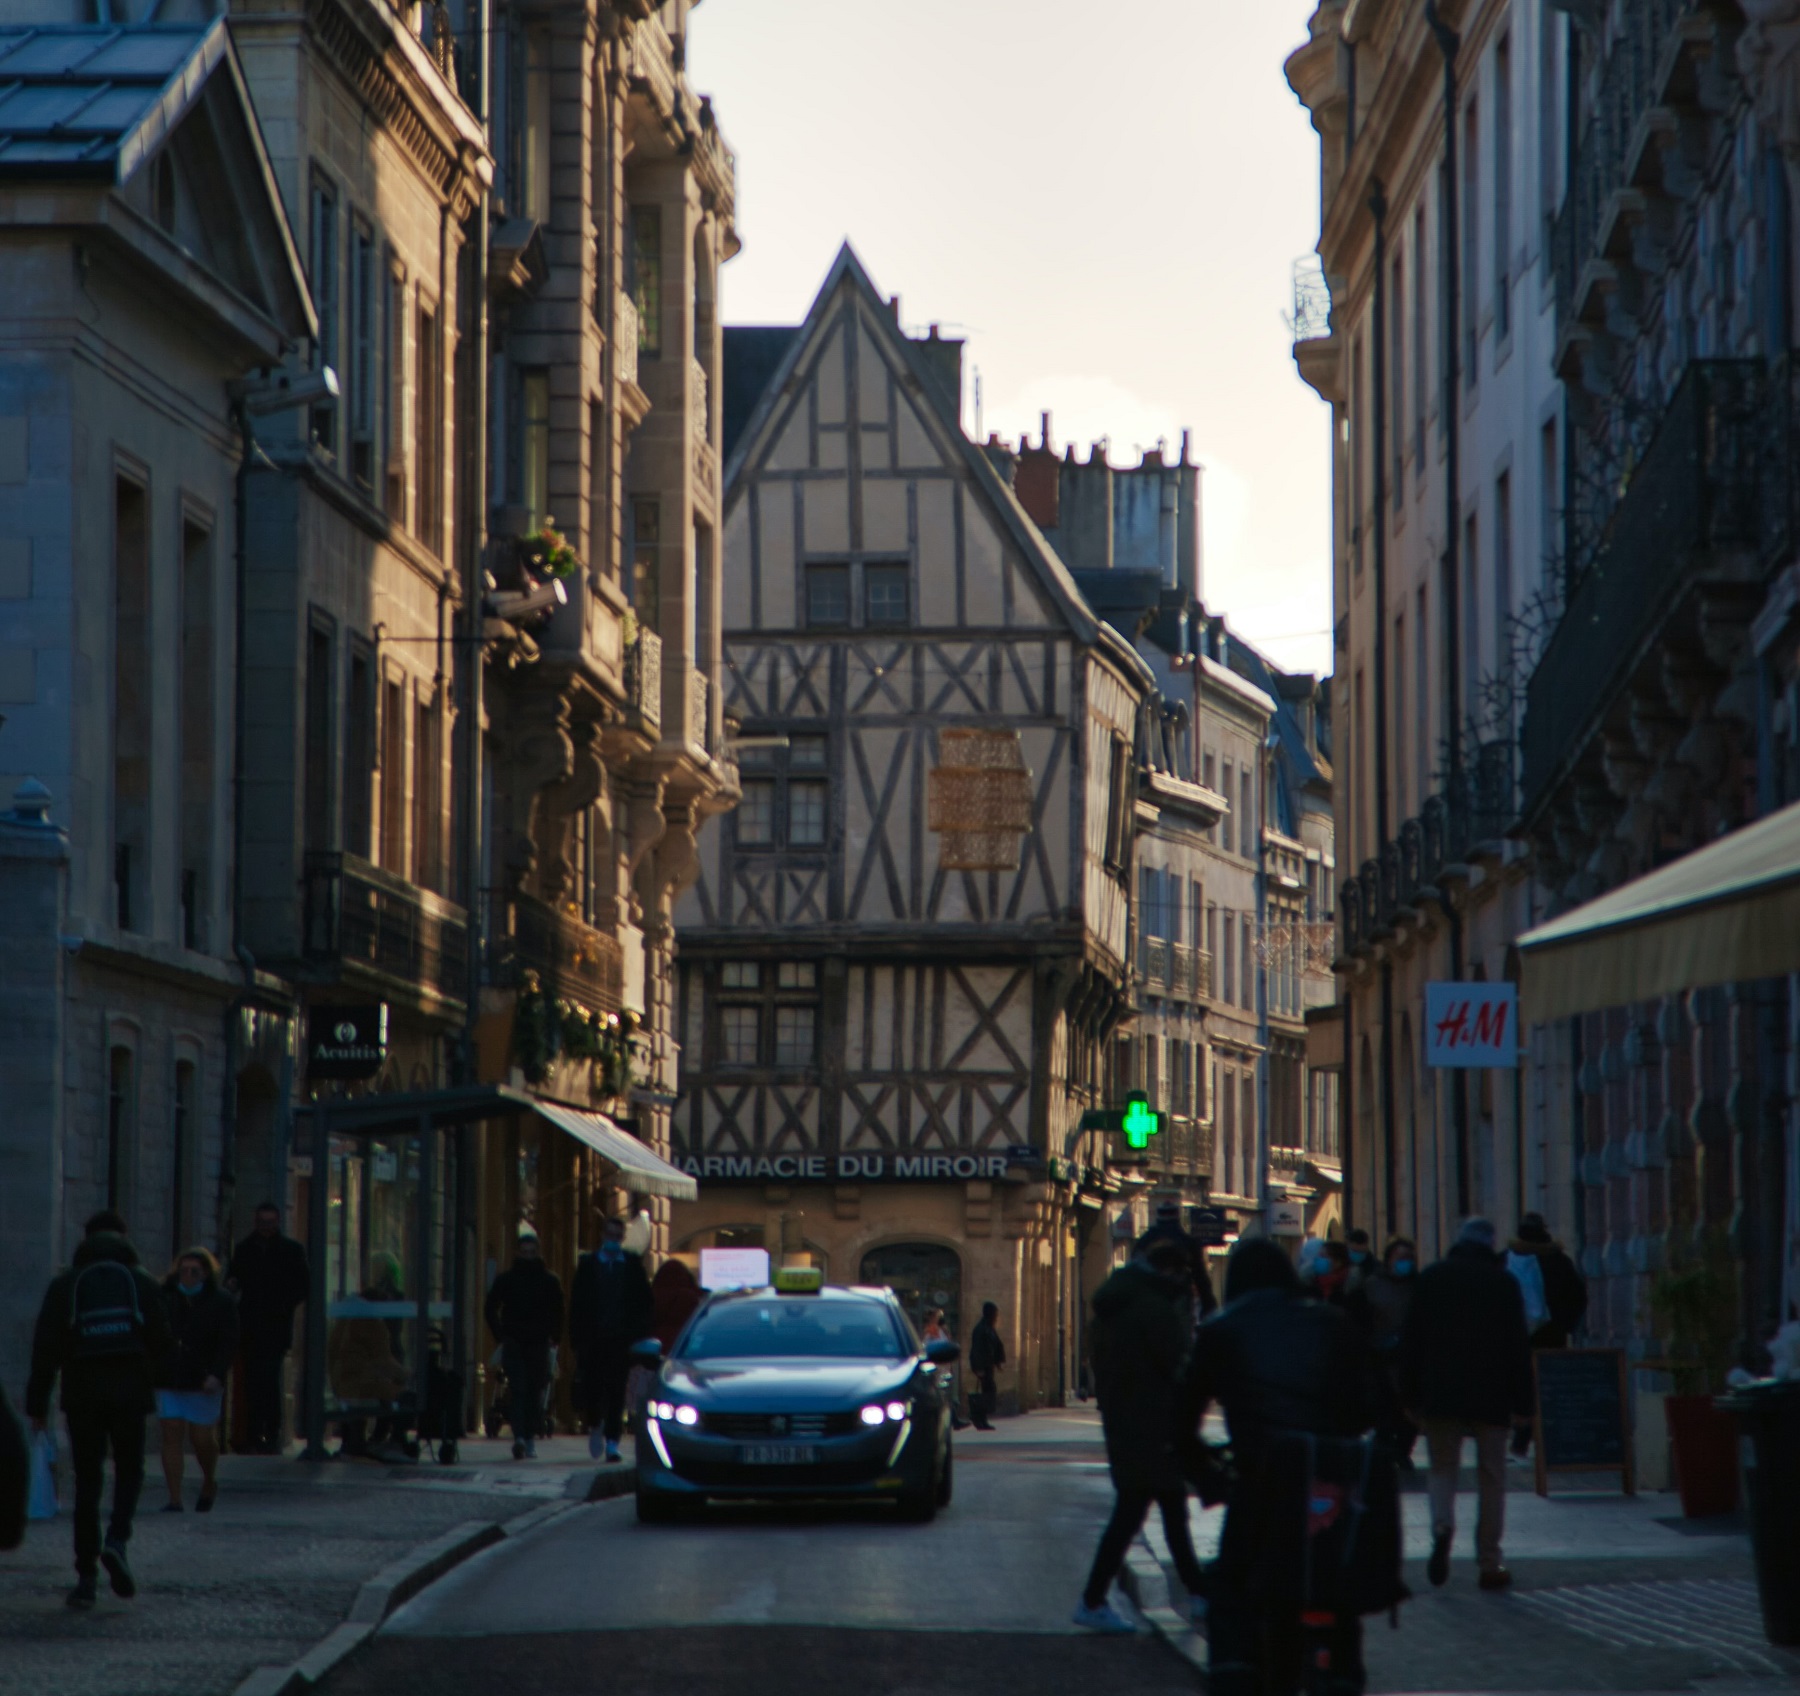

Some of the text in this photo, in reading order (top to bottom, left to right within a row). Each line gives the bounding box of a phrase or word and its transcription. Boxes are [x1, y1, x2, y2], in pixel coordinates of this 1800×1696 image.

[1436, 1001, 1508, 1049] H&M
[313, 1043, 377, 1060] Acuitis
[838, 1155, 884, 1178] DU
[895, 1155, 1008, 1178] MIROIR
